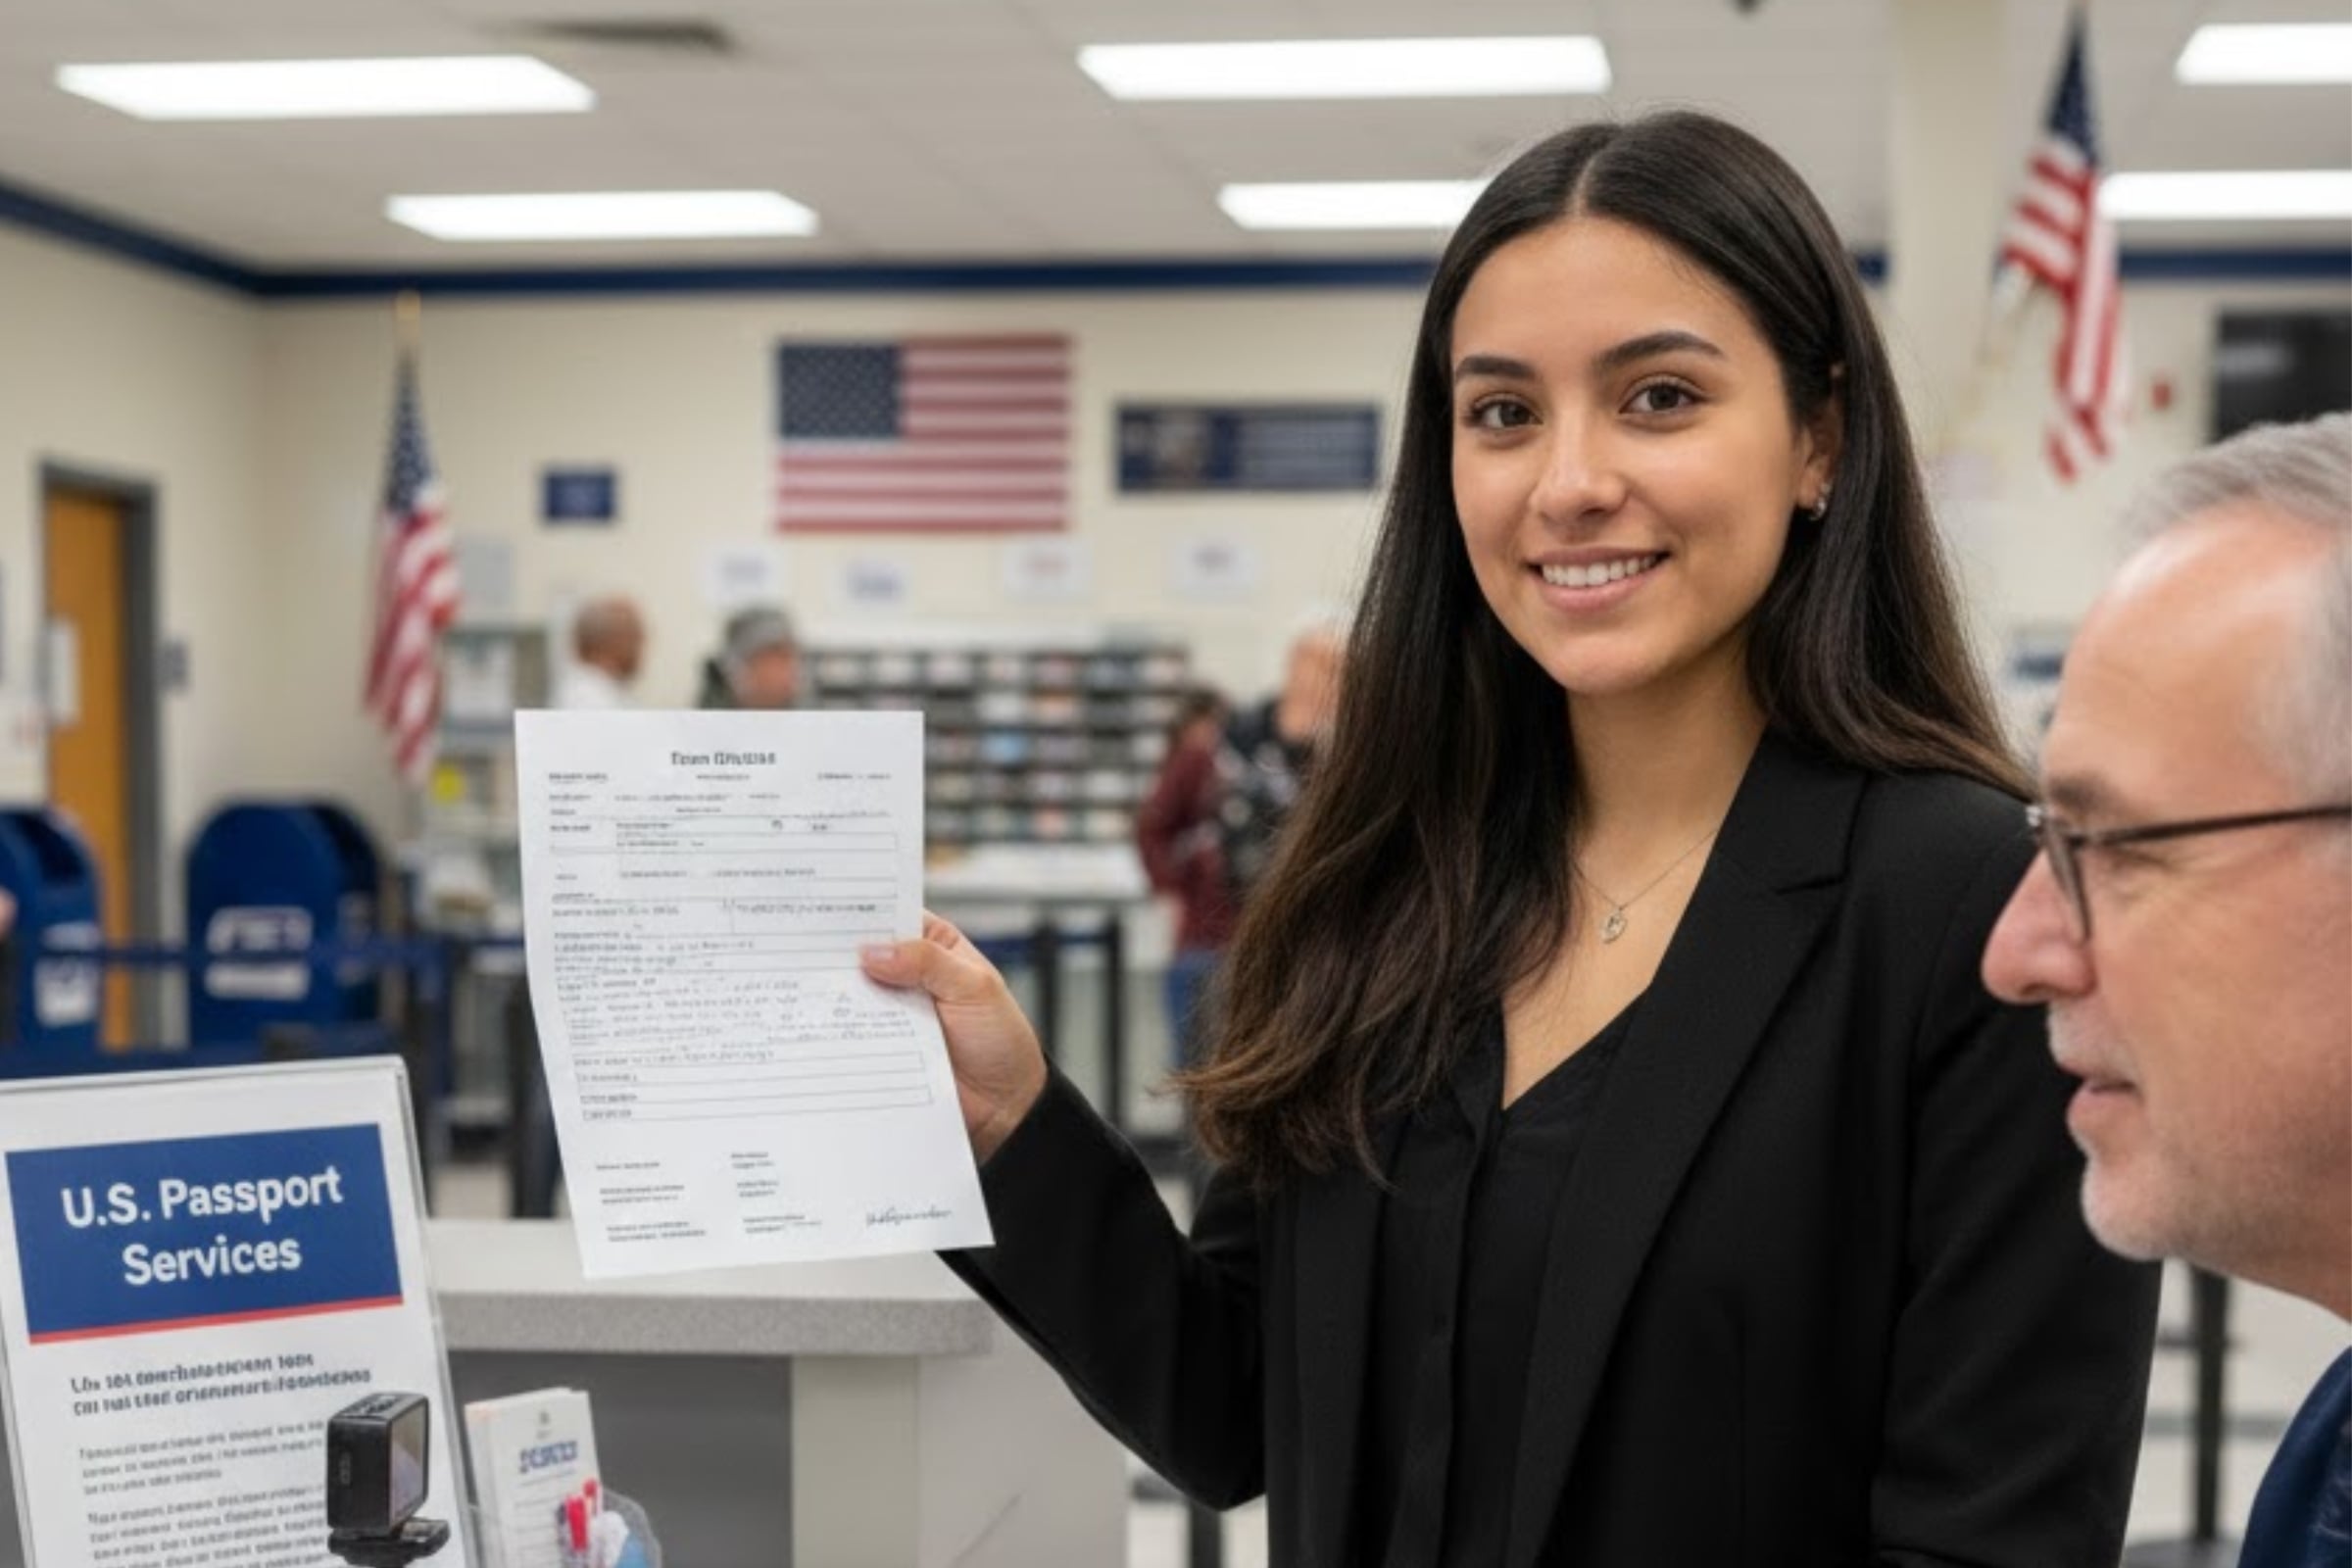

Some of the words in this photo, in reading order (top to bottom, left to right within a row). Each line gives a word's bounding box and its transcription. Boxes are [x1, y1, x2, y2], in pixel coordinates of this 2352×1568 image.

[62, 1183, 151, 1228] U.S.
[160, 1165, 343, 1225] Passport
[122, 1234, 302, 1286] Services
